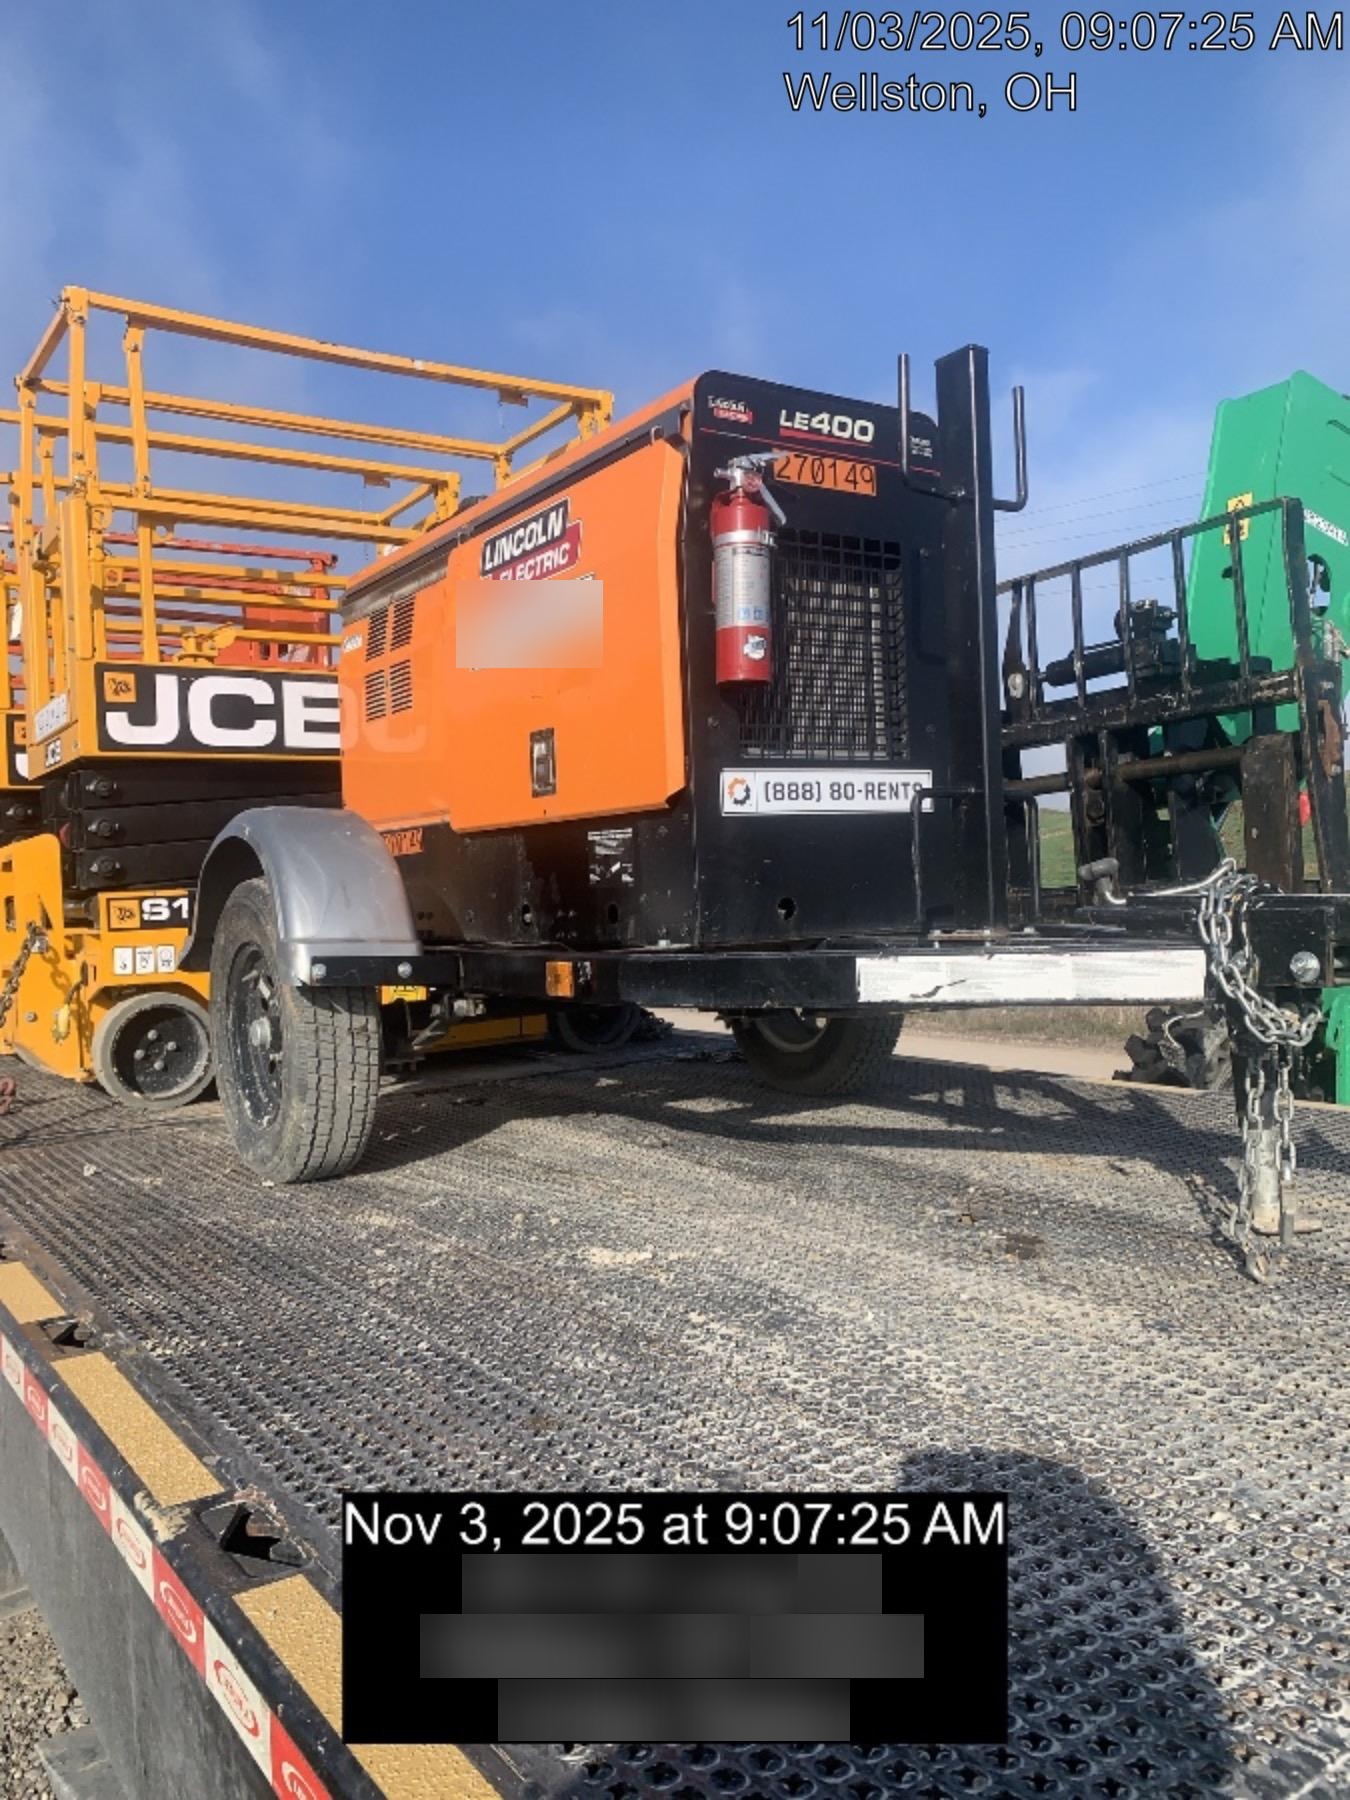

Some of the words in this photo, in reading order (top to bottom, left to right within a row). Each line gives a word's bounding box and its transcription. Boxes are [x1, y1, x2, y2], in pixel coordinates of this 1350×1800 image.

[779, 409, 875, 443] LE400
[776, 453, 875, 493] 270149
[484, 506, 565, 572] LINCOLN
